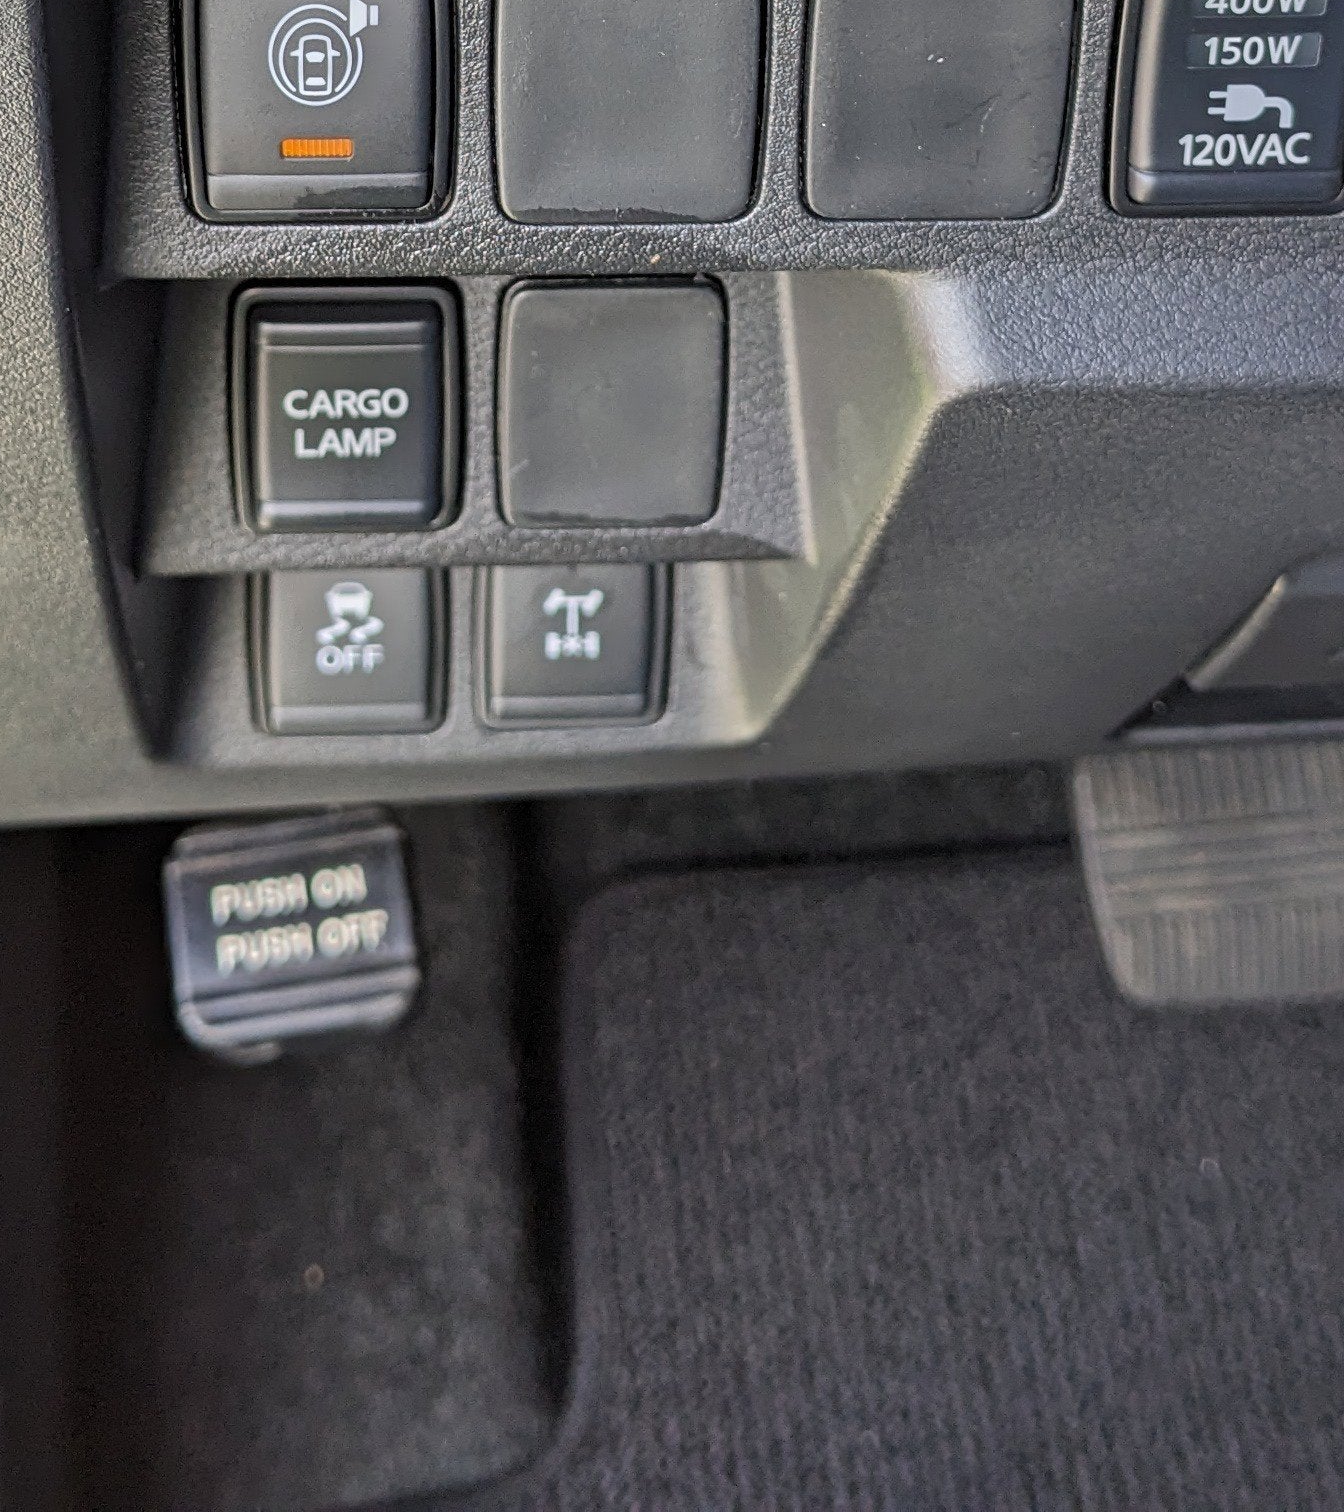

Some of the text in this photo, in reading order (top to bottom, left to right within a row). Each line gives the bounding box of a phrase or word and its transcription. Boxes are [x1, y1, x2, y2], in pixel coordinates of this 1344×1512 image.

[1204, 34, 1302, 66] 150W
[1178, 132, 1312, 167] 120VAC
[282, 388, 409, 419] CARGO
[294, 427, 397, 459] LAMP
[315, 643, 386, 675] OFF
[211, 863, 367, 926] PUSH ON
[216, 909, 389, 978] PUSH OFF
